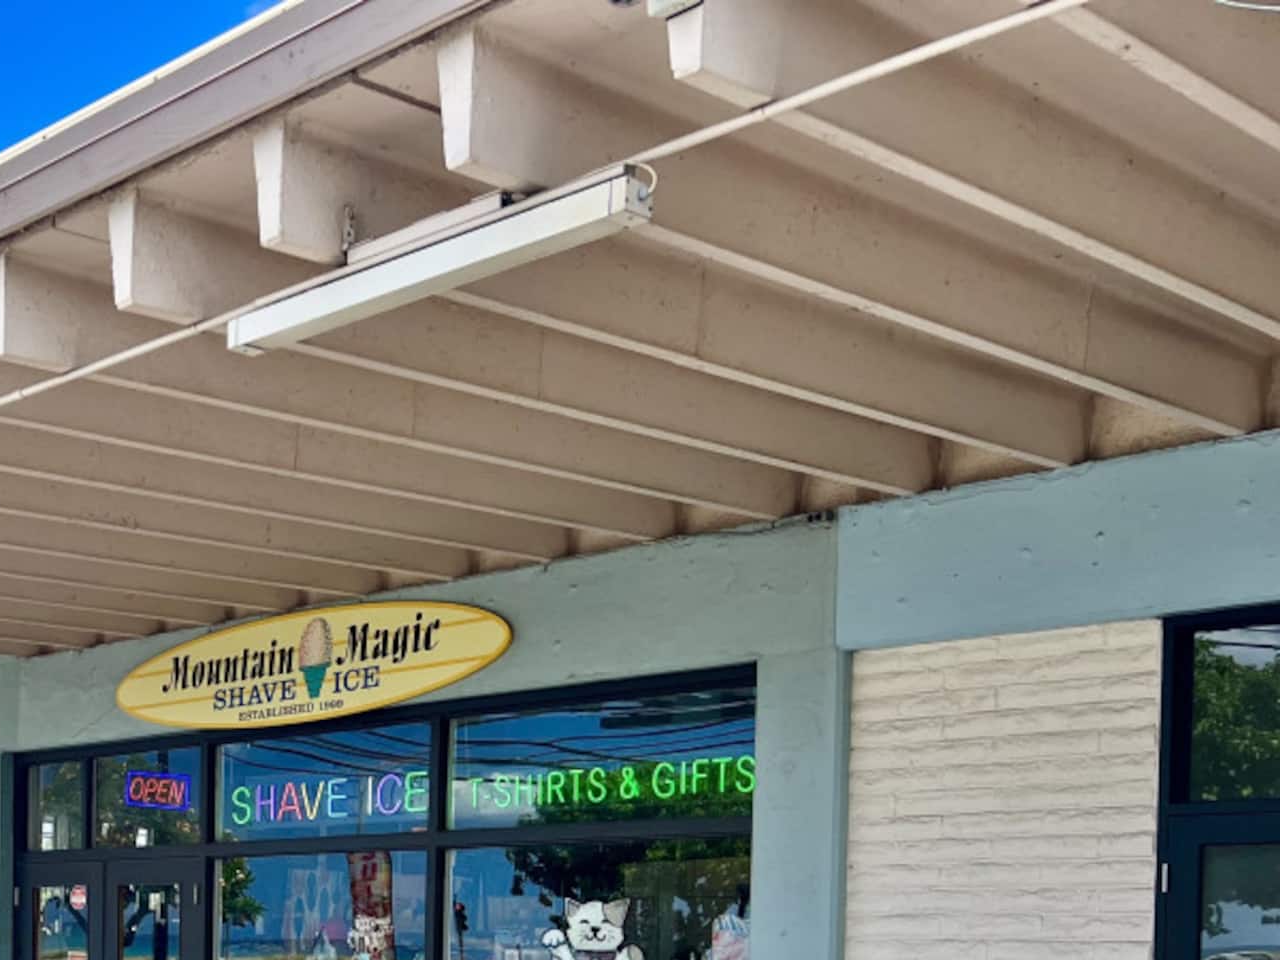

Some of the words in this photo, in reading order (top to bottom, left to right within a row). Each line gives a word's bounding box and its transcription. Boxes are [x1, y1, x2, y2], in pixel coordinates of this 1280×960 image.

[162, 639, 294, 693] Mountain
[336, 612, 440, 664] Magic
[213, 679, 297, 711] SHAVE
[333, 665, 380, 693] ICE
[239, 703, 314, 721] ESTABLISHED
[129, 776, 185, 806] OPEN
[231, 777, 349, 826] SHAVE
[365, 770, 430, 817] ICE
[469, 766, 608, 810] T-SHIRTS
[619, 765, 640, 800] &
[651, 754, 757, 799] GIFTS
